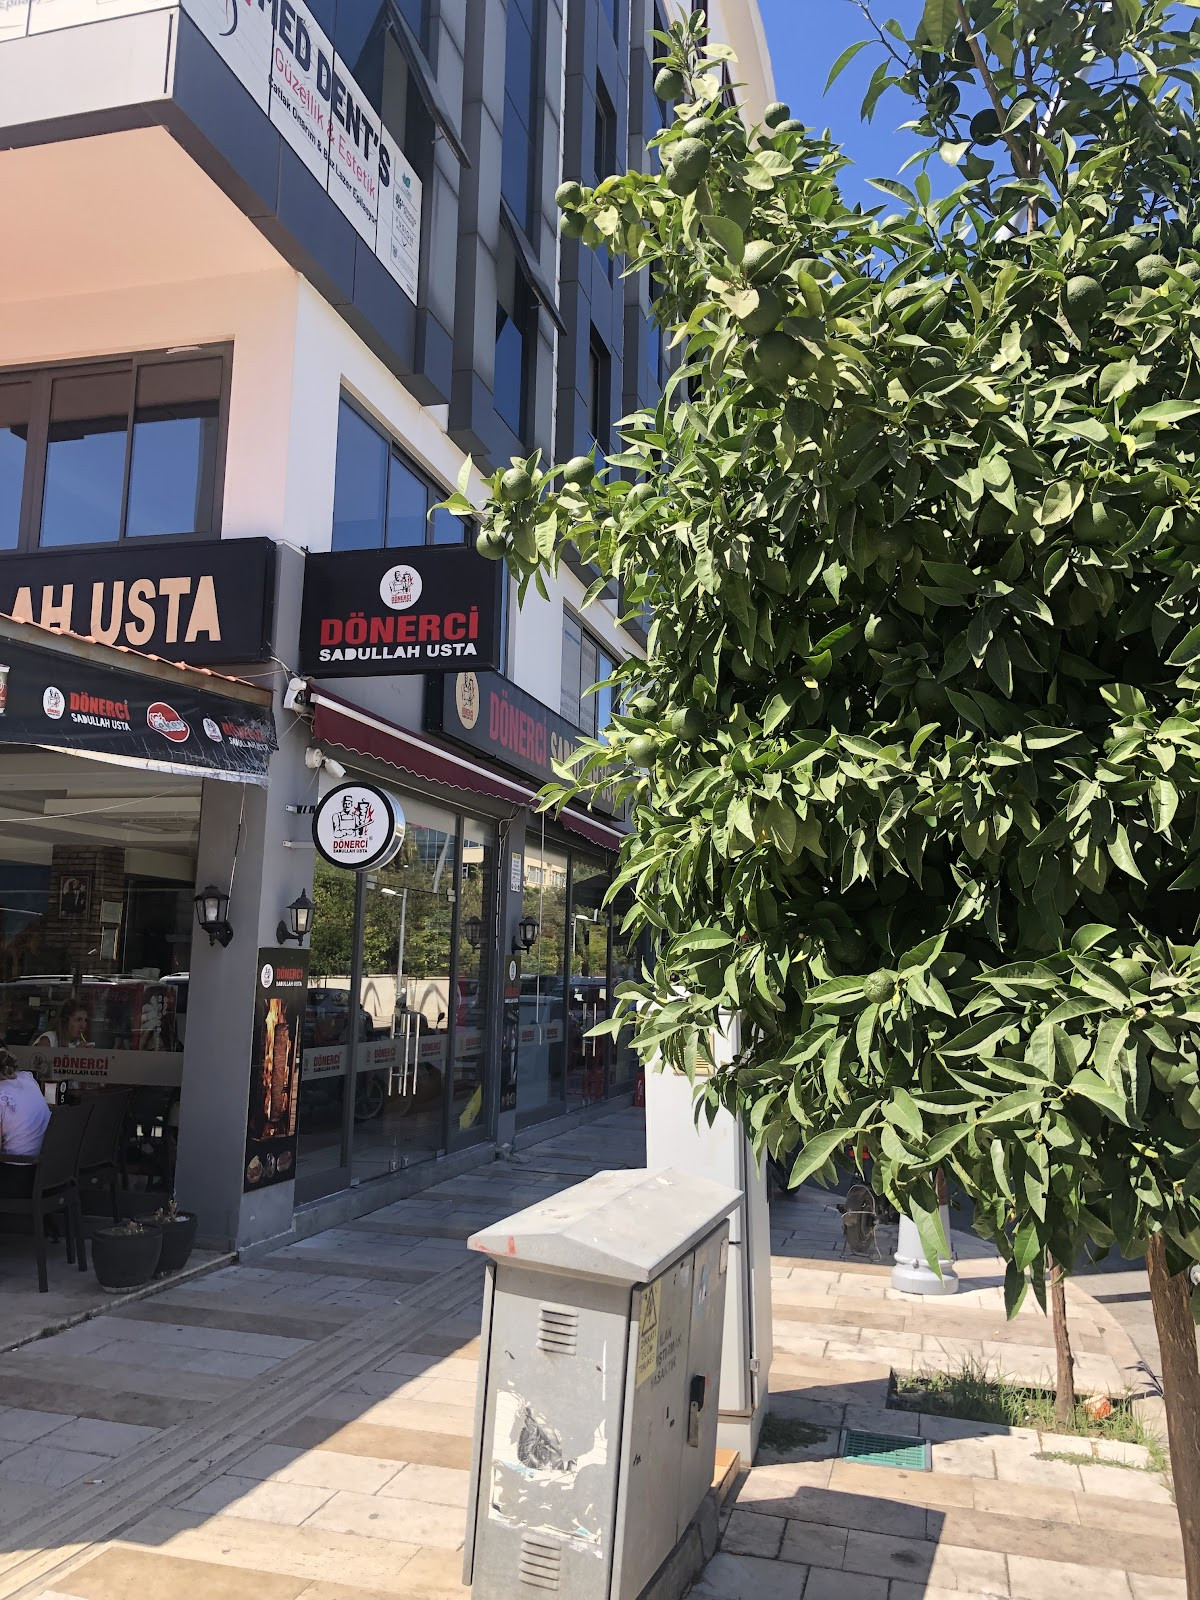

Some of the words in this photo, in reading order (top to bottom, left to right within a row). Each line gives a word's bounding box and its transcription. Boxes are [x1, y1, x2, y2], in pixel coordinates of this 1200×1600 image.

[275, 48, 324, 129] Güzellik
[327, 120, 335, 146] &
[339, 135, 376, 200] Estetik
[317, 48, 390, 187] DENT'S
[90, 575, 221, 646] USTA
[320, 606, 478, 645] DÖNERCİ
[319, 645, 420, 662] SADULLAH
[427, 642, 477, 657] USTA
[69, 692, 130, 720] DÖNERCİ
[71, 713, 110, 728] SADULLAH
[112, 720, 131, 731] USTA
[489, 689, 547, 768] DÖNERCİ
[333, 838, 368, 848] DÖNERCİ
[53, 1054, 108, 1069] DÖNERCİ
